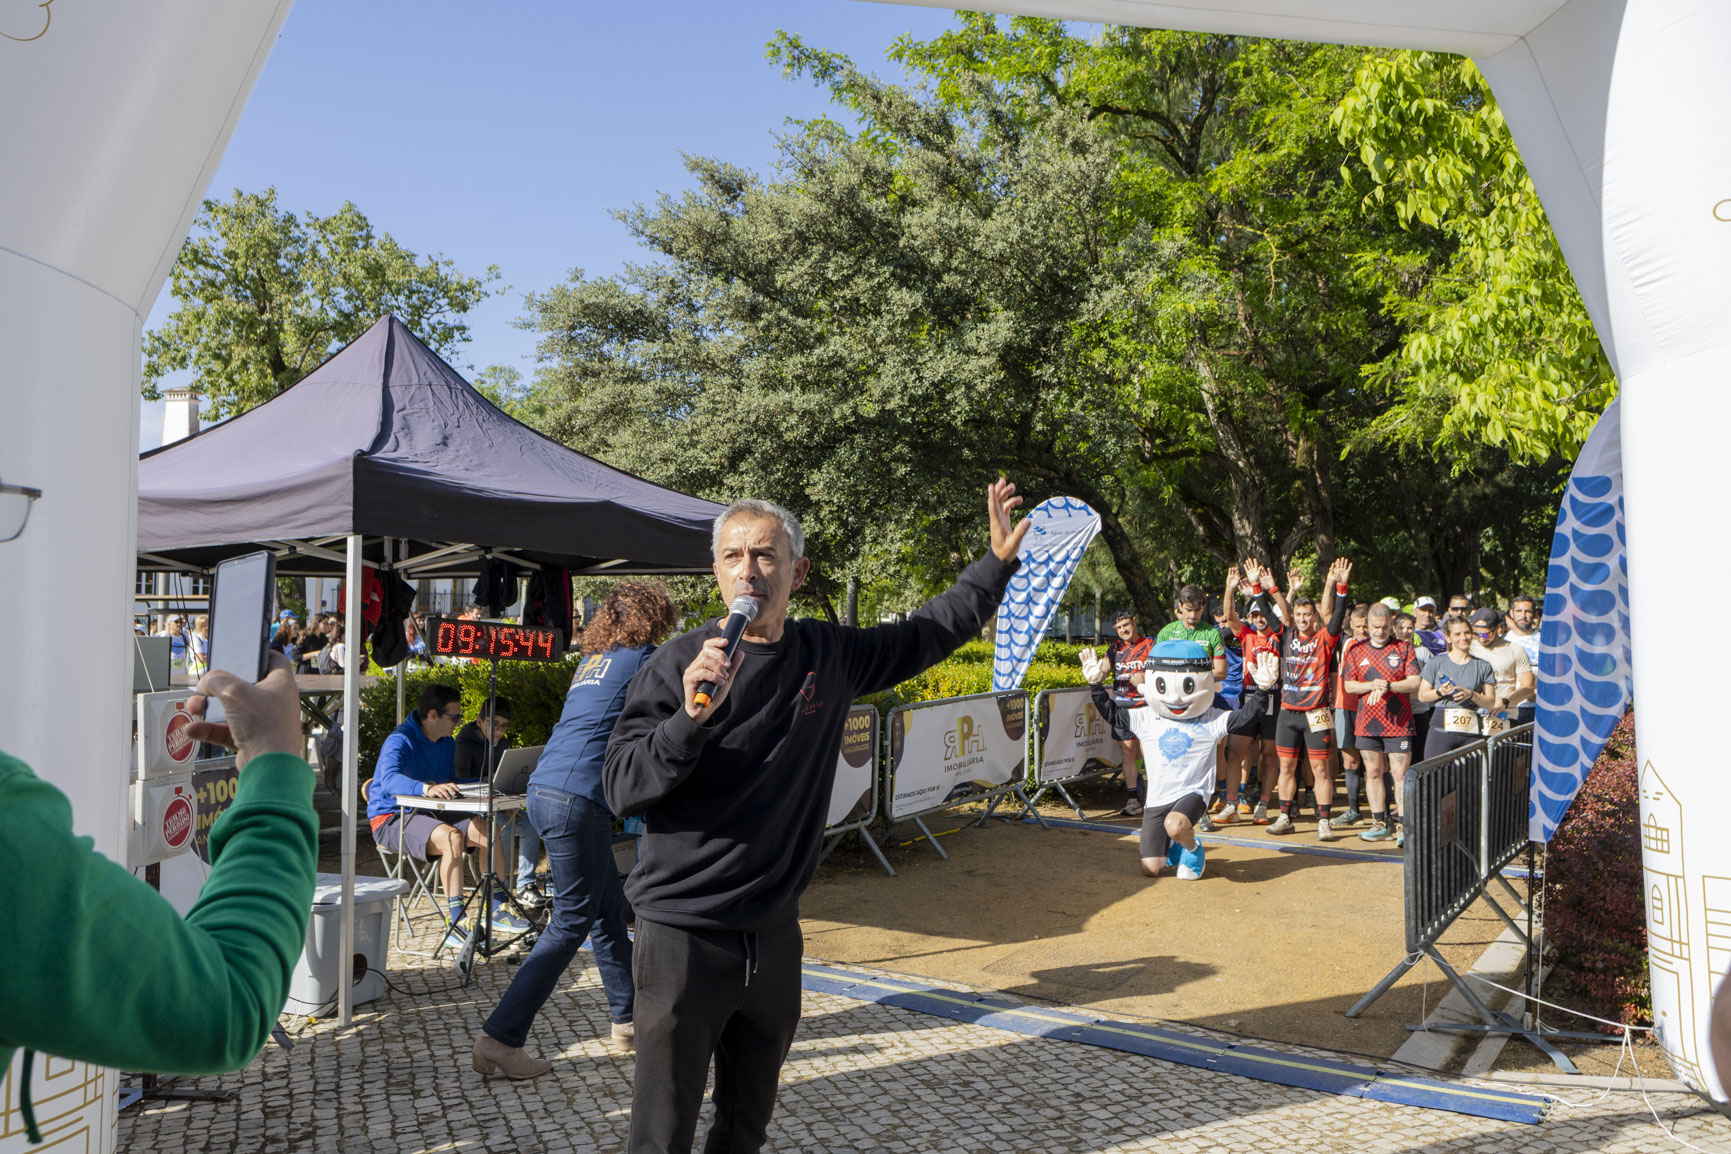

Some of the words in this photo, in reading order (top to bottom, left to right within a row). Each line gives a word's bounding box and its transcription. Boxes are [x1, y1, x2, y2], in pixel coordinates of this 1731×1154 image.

[437, 622, 553, 659] 09:15:44
[1453, 715, 1471, 725] 207
[944, 756, 984, 773] IMOBILIÁRIA
[196, 776, 239, 804] +100
[895, 790, 916, 801] ESTAMOS
